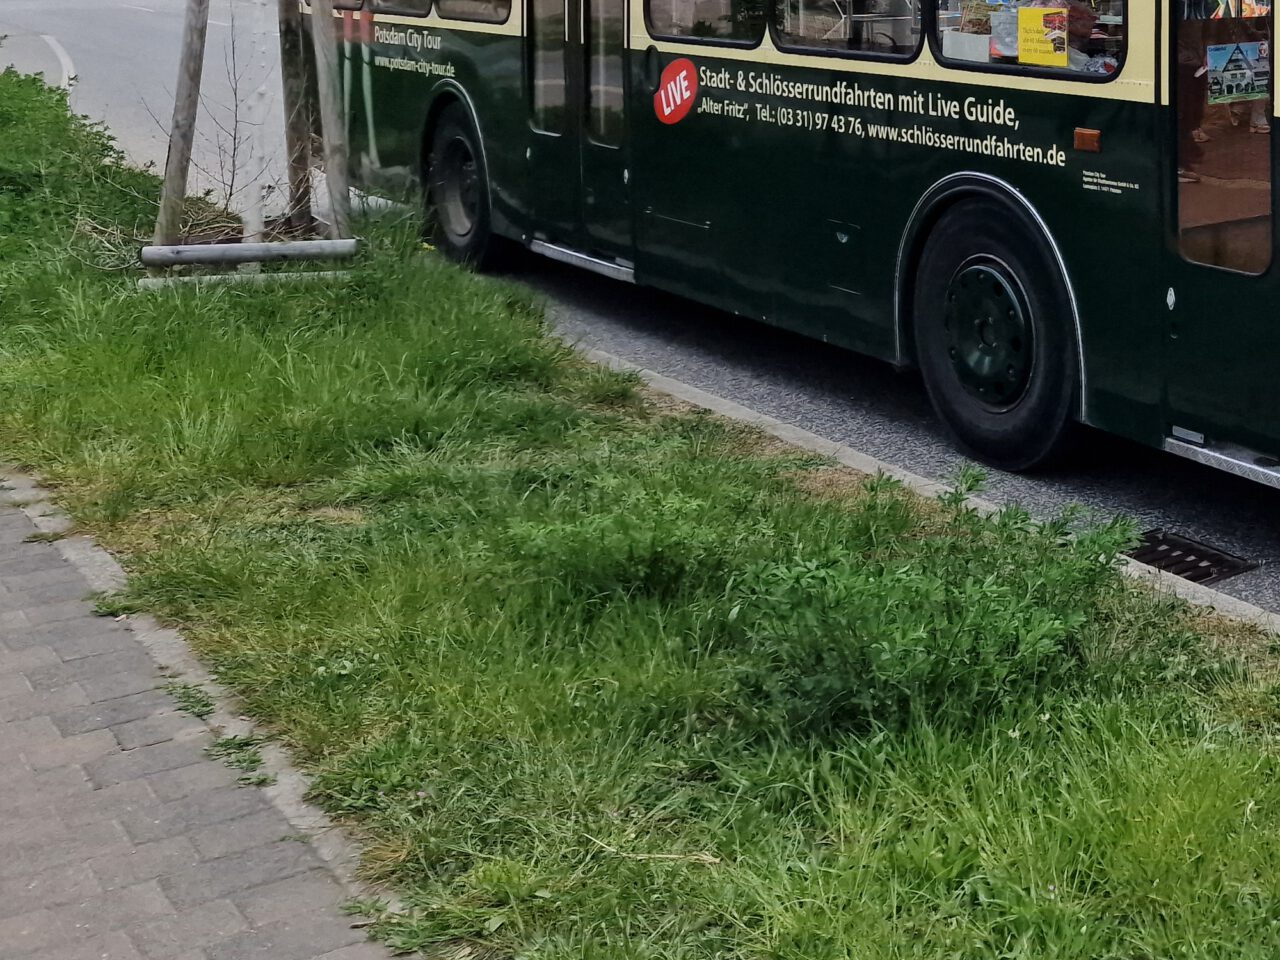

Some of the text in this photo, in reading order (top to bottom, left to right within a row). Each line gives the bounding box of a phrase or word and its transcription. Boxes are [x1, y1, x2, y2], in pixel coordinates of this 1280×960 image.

[374, 26, 441, 52] Potsdam City Tour
[660, 70, 692, 116] LIVE
[699, 66, 1020, 130] Stadt- & Schlösserrundfahrten mit Live Guide,
[777, 107, 793, 126] (03
[796, 110, 812, 131] 31)
[815, 113, 828, 130] 97
[831, 115, 845, 133] 43
[848, 117, 865, 138] 76,
[867, 123, 1066, 166] www.schlösserrundfahrten.de
